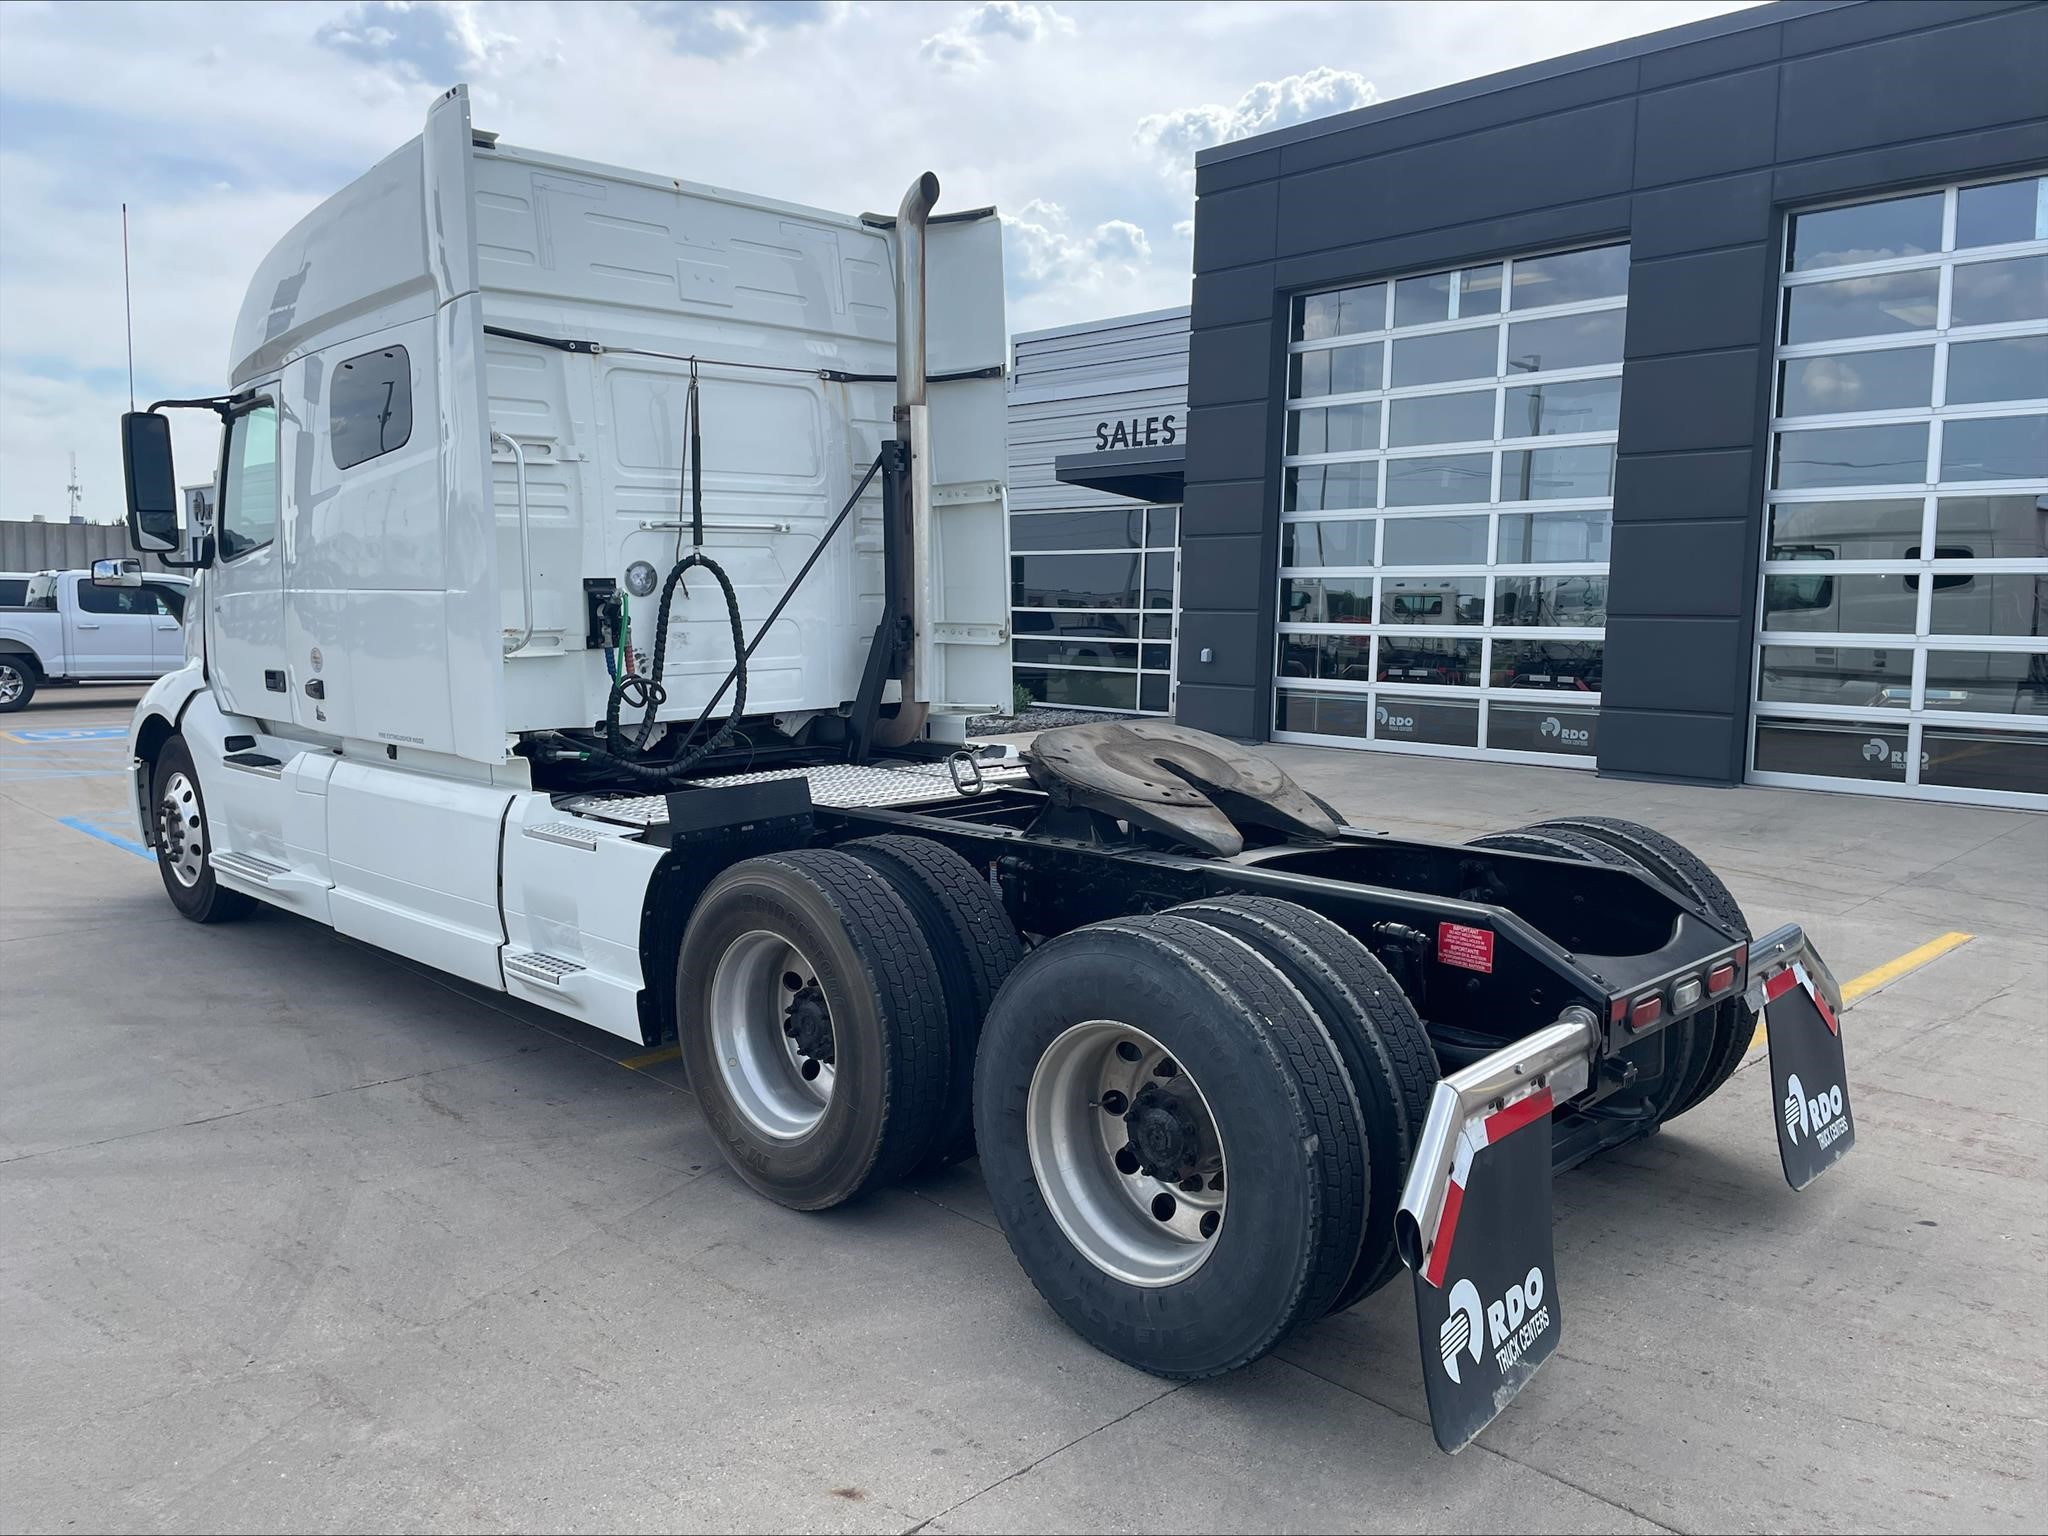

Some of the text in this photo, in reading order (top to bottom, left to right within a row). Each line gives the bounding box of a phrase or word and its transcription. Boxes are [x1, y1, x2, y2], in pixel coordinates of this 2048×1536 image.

[1095, 415, 1176, 451] SALES
[1389, 716, 1414, 726] RDO
[1561, 728, 1589, 740] RDO
[1808, 1084, 1842, 1132] RDO
[1487, 1266, 1544, 1350] RDO
[1495, 1305, 1550, 1375] TRUCK CENTERS
